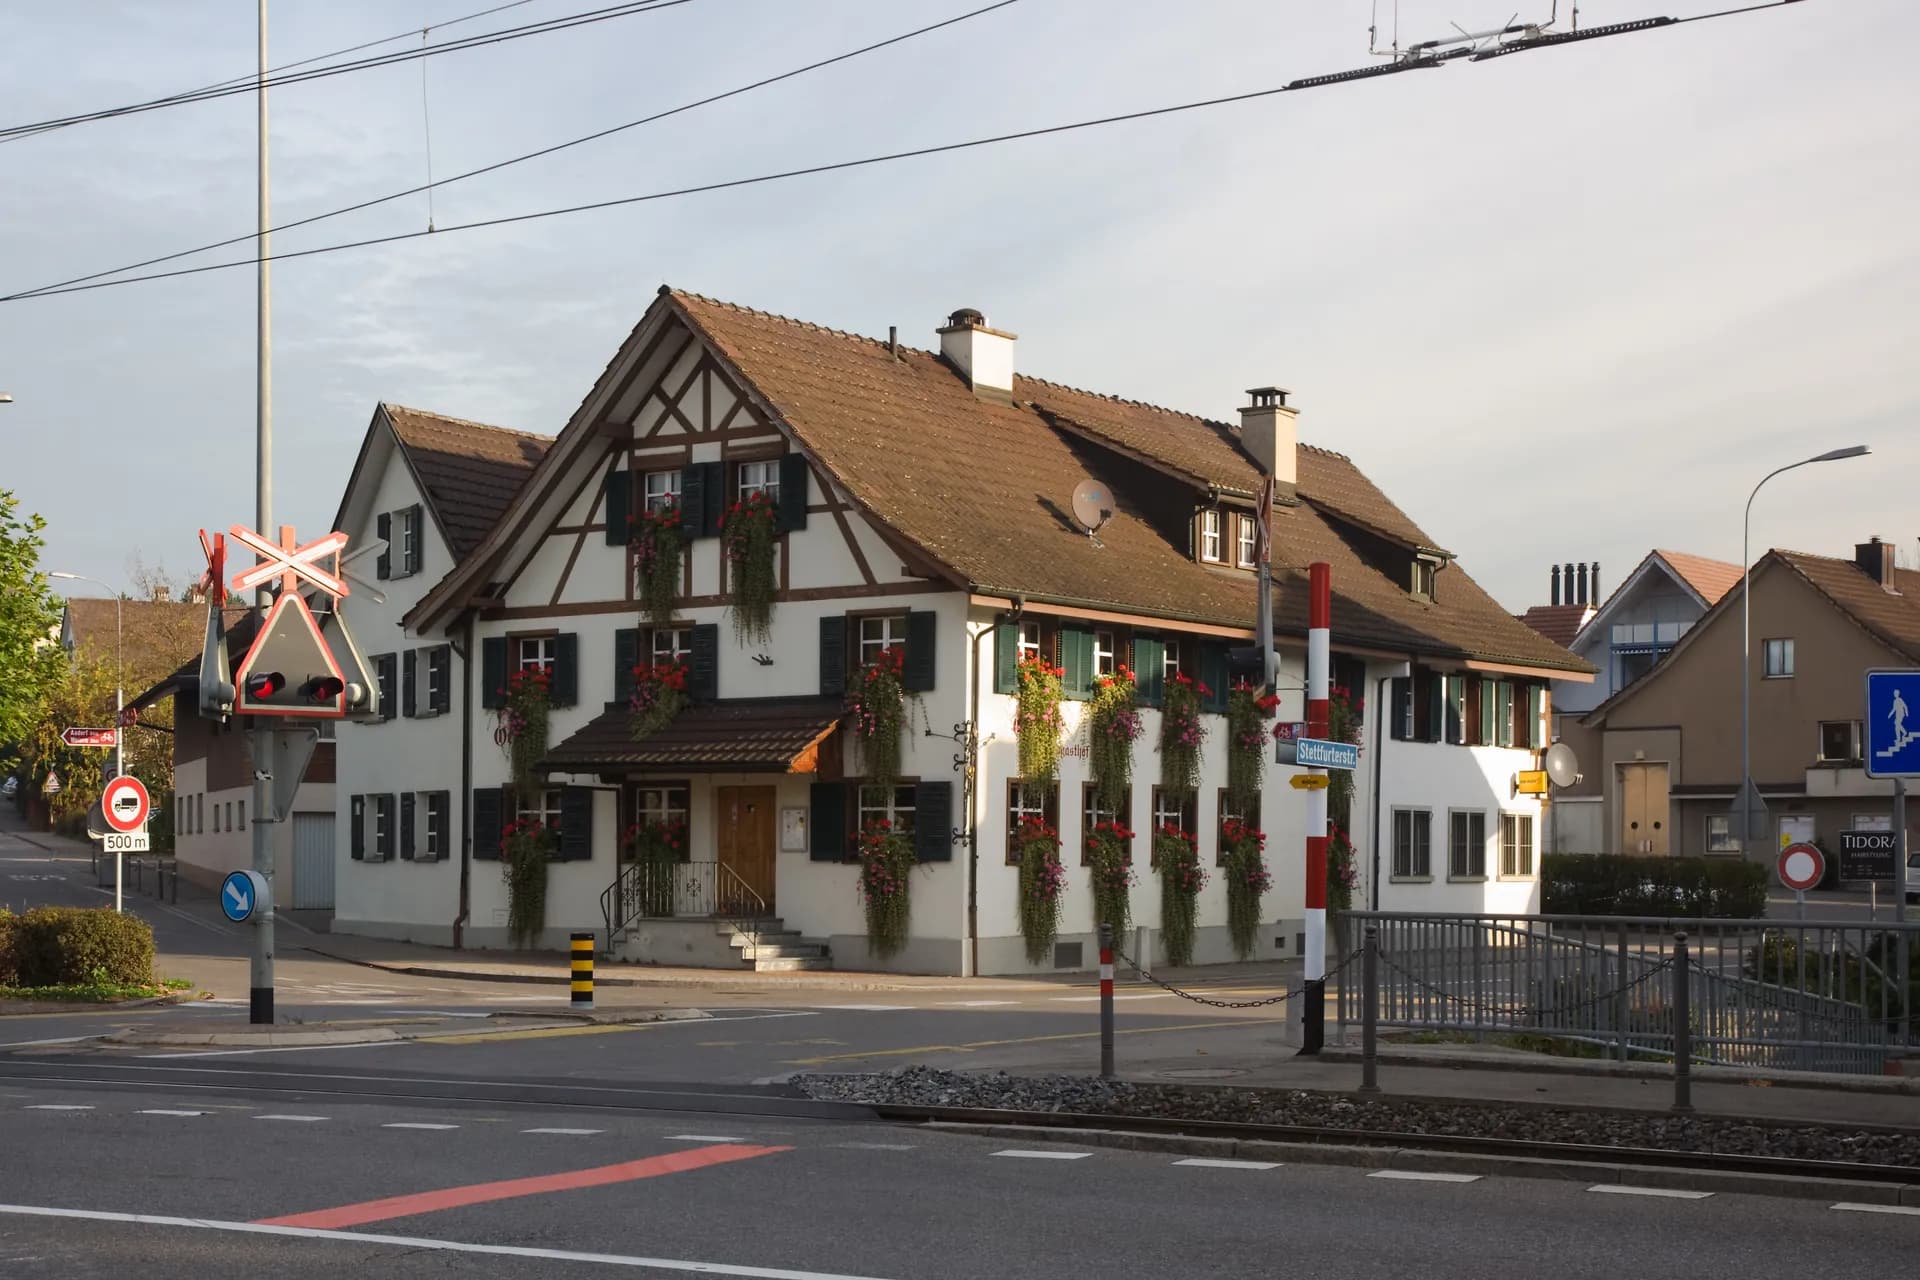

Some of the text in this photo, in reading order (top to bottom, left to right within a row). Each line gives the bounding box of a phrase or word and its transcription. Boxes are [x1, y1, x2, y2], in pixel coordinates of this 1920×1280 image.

[1300, 742, 1355, 765] Stettfurterstr.
[108, 835, 146, 849] 500 m
